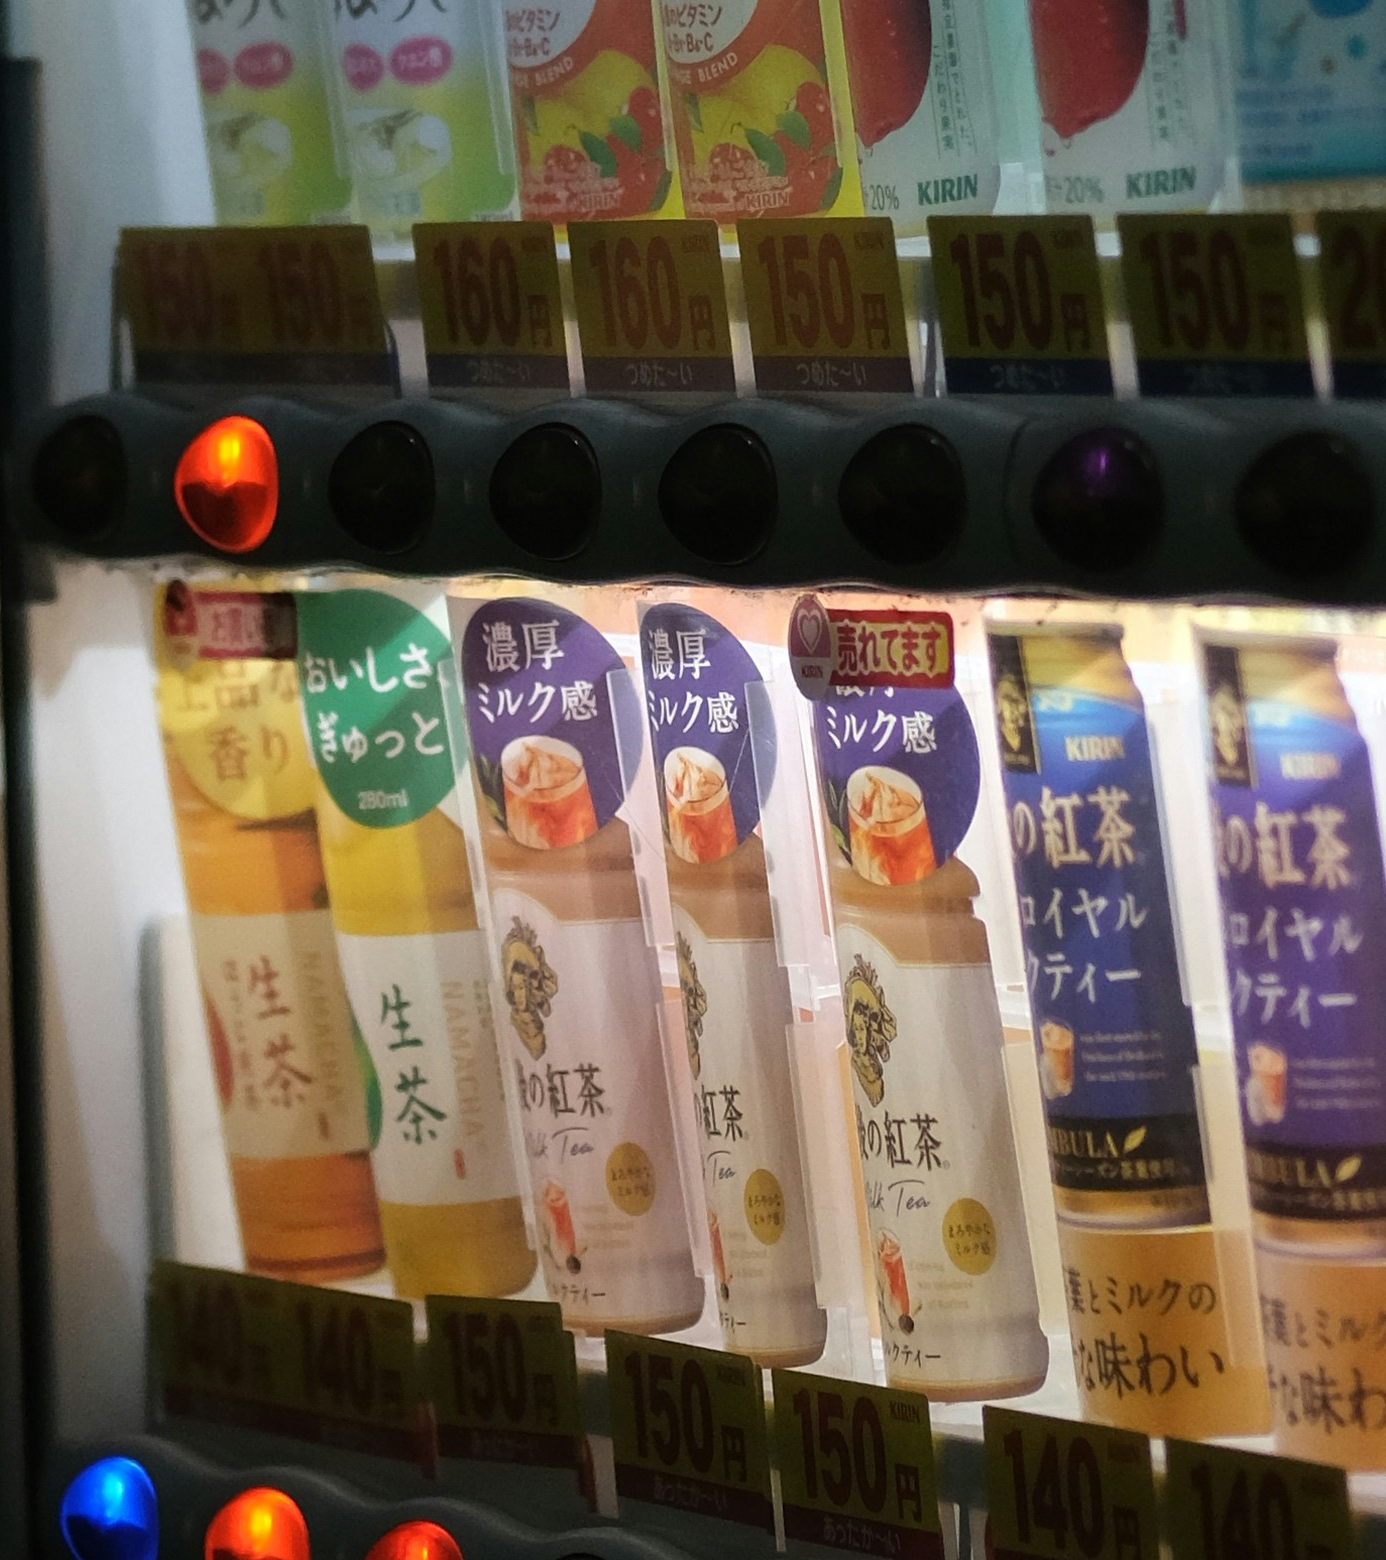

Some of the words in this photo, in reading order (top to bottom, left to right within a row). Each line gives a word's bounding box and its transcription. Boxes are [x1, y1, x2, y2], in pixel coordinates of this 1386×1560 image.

[917, 173, 979, 207] KIRIN
[1125, 165, 1197, 199] KIRIN
[434, 235, 552, 349] 160円
[588, 234, 715, 352] 160円
[758, 232, 890, 351] 150円
[949, 231, 1090, 352] 150円
[1139, 229, 1293, 352] 150円
[304, 642, 438, 693] おいしさ
[480, 618, 565, 676] 濃厚
[647, 626, 713, 684] 濃厚
[836, 620, 942, 677] 売れてます
[477, 679, 599, 724] ミルク感
[648, 691, 740, 735] ミルク感
[209, 724, 289, 781] 香り
[316, 711, 445, 765] ぎゅっと
[825, 709, 939, 755] ミルク感
[1064, 735, 1126, 763] KIRIN
[246, 954, 313, 1110] 生茶
[379, 981, 447, 1145] 生茶
[887, 1179, 932, 1217] Tea
[445, 1312, 558, 1425] 150円
[624, 1350, 748, 1482] 150円
[889, 1400, 922, 1424] KIRIN
[792, 1384, 923, 1522] 150円
